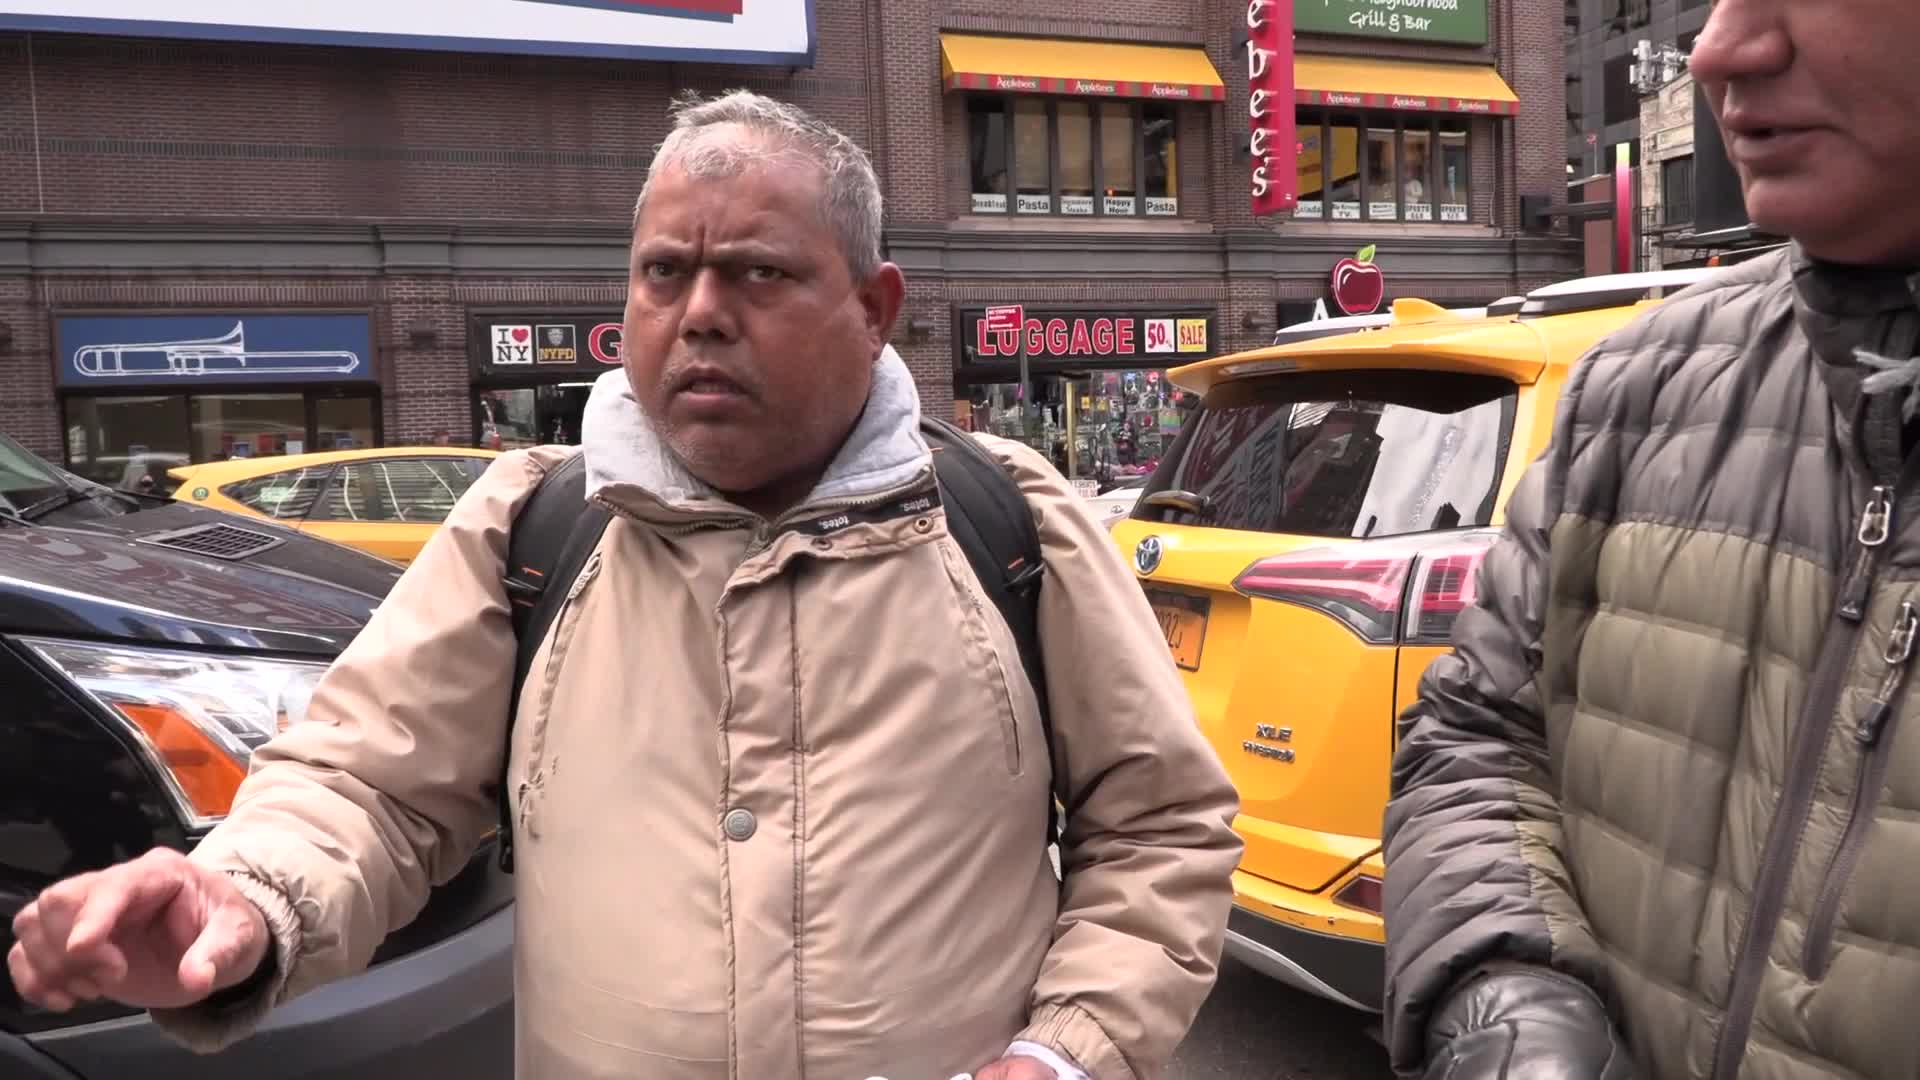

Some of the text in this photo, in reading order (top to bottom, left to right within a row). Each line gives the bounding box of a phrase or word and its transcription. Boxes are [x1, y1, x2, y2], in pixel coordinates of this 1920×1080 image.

[1349, 9, 1386, 28] Grill
[1388, 13, 1400, 32] &
[1018, 199, 1049, 210] Pasta
[1146, 202, 1175, 212] Pasta
[498, 328, 510, 344] I
[977, 318, 1135, 355] LUGGAGE
[1180, 325, 1204, 345] SALE
[496, 345, 529, 361] NY
[539, 348, 575, 361] NYPD
[1256, 723, 1293, 742] XLE
